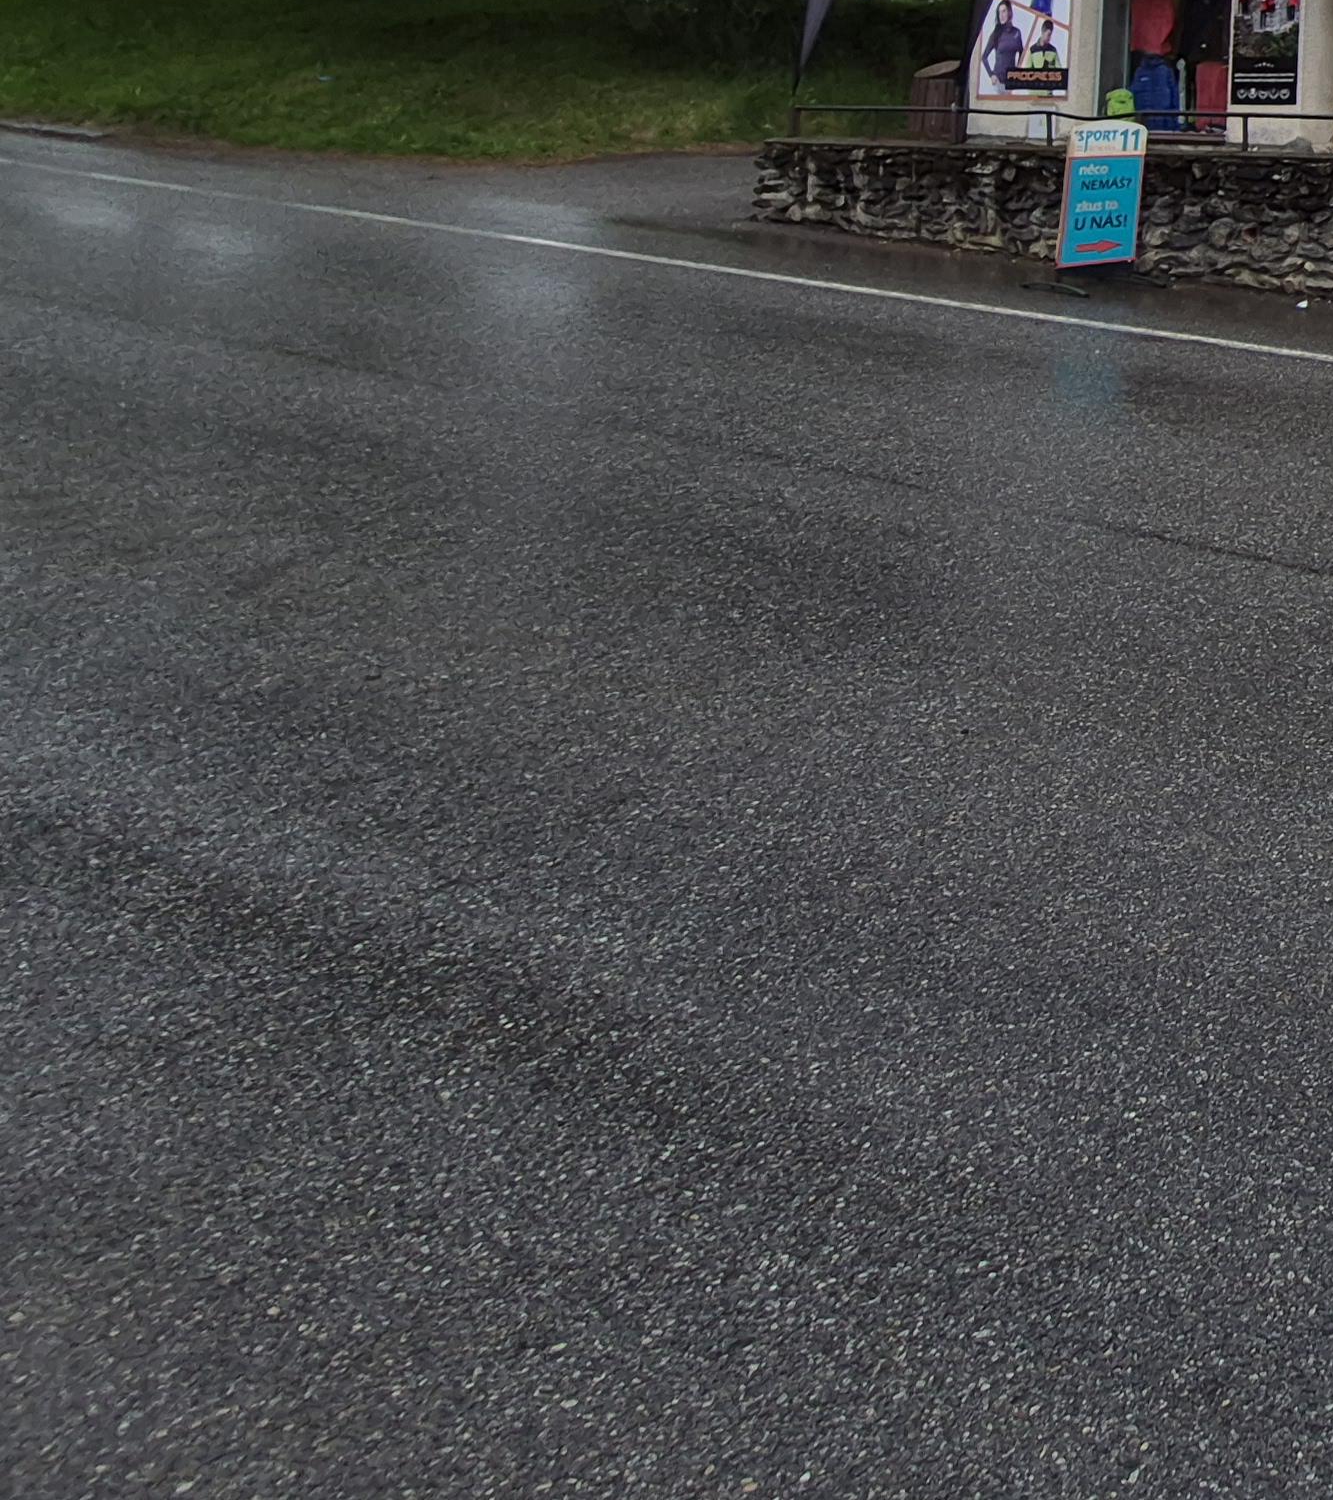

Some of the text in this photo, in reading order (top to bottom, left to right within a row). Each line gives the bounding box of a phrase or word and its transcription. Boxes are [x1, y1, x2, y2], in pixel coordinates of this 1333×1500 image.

[1120, 128, 1141, 151] 11
[1074, 212, 1128, 231] U NÁS!
